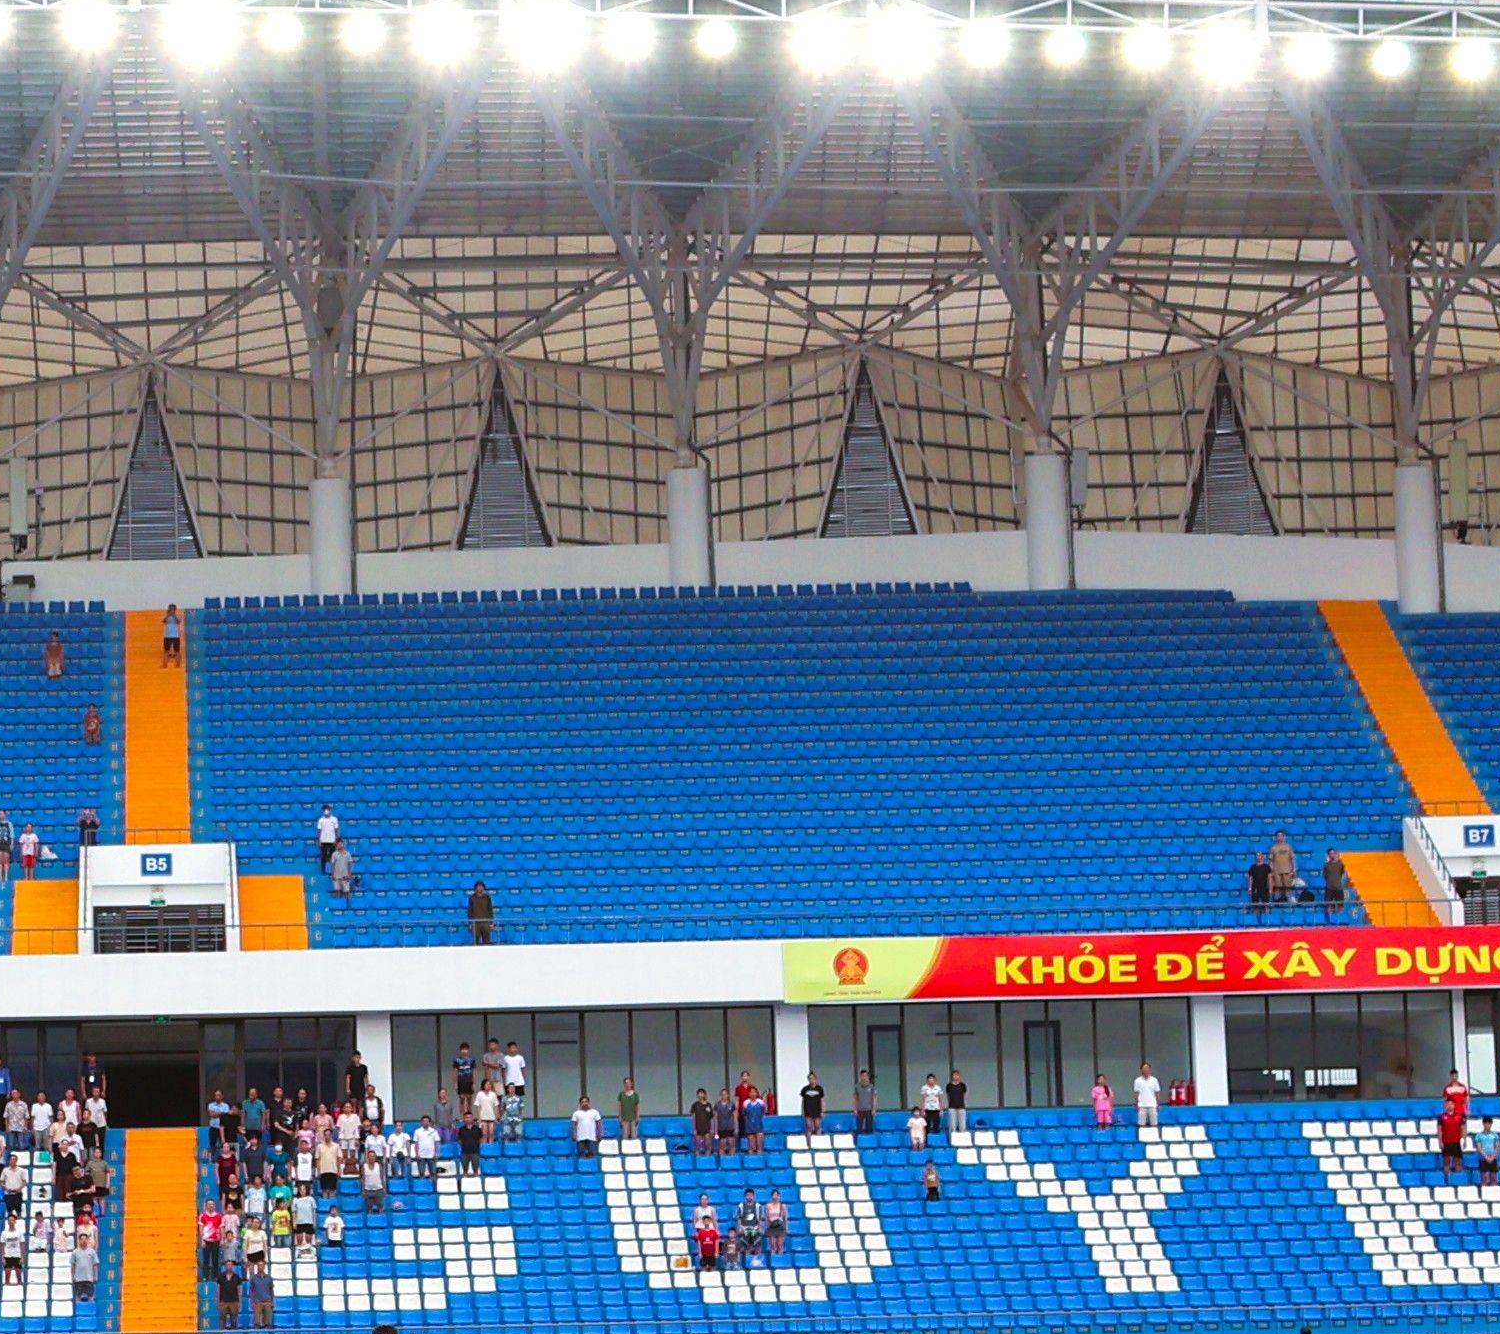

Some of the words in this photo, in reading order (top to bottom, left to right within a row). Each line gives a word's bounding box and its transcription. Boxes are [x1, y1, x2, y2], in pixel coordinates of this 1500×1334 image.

[1469, 829, 1489, 842] B7
[146, 858, 167, 871] B5
[996, 943, 1137, 983] KHỎE
[1154, 936, 1224, 980] ĐỂ
[1244, 942, 1356, 978] XÂY
